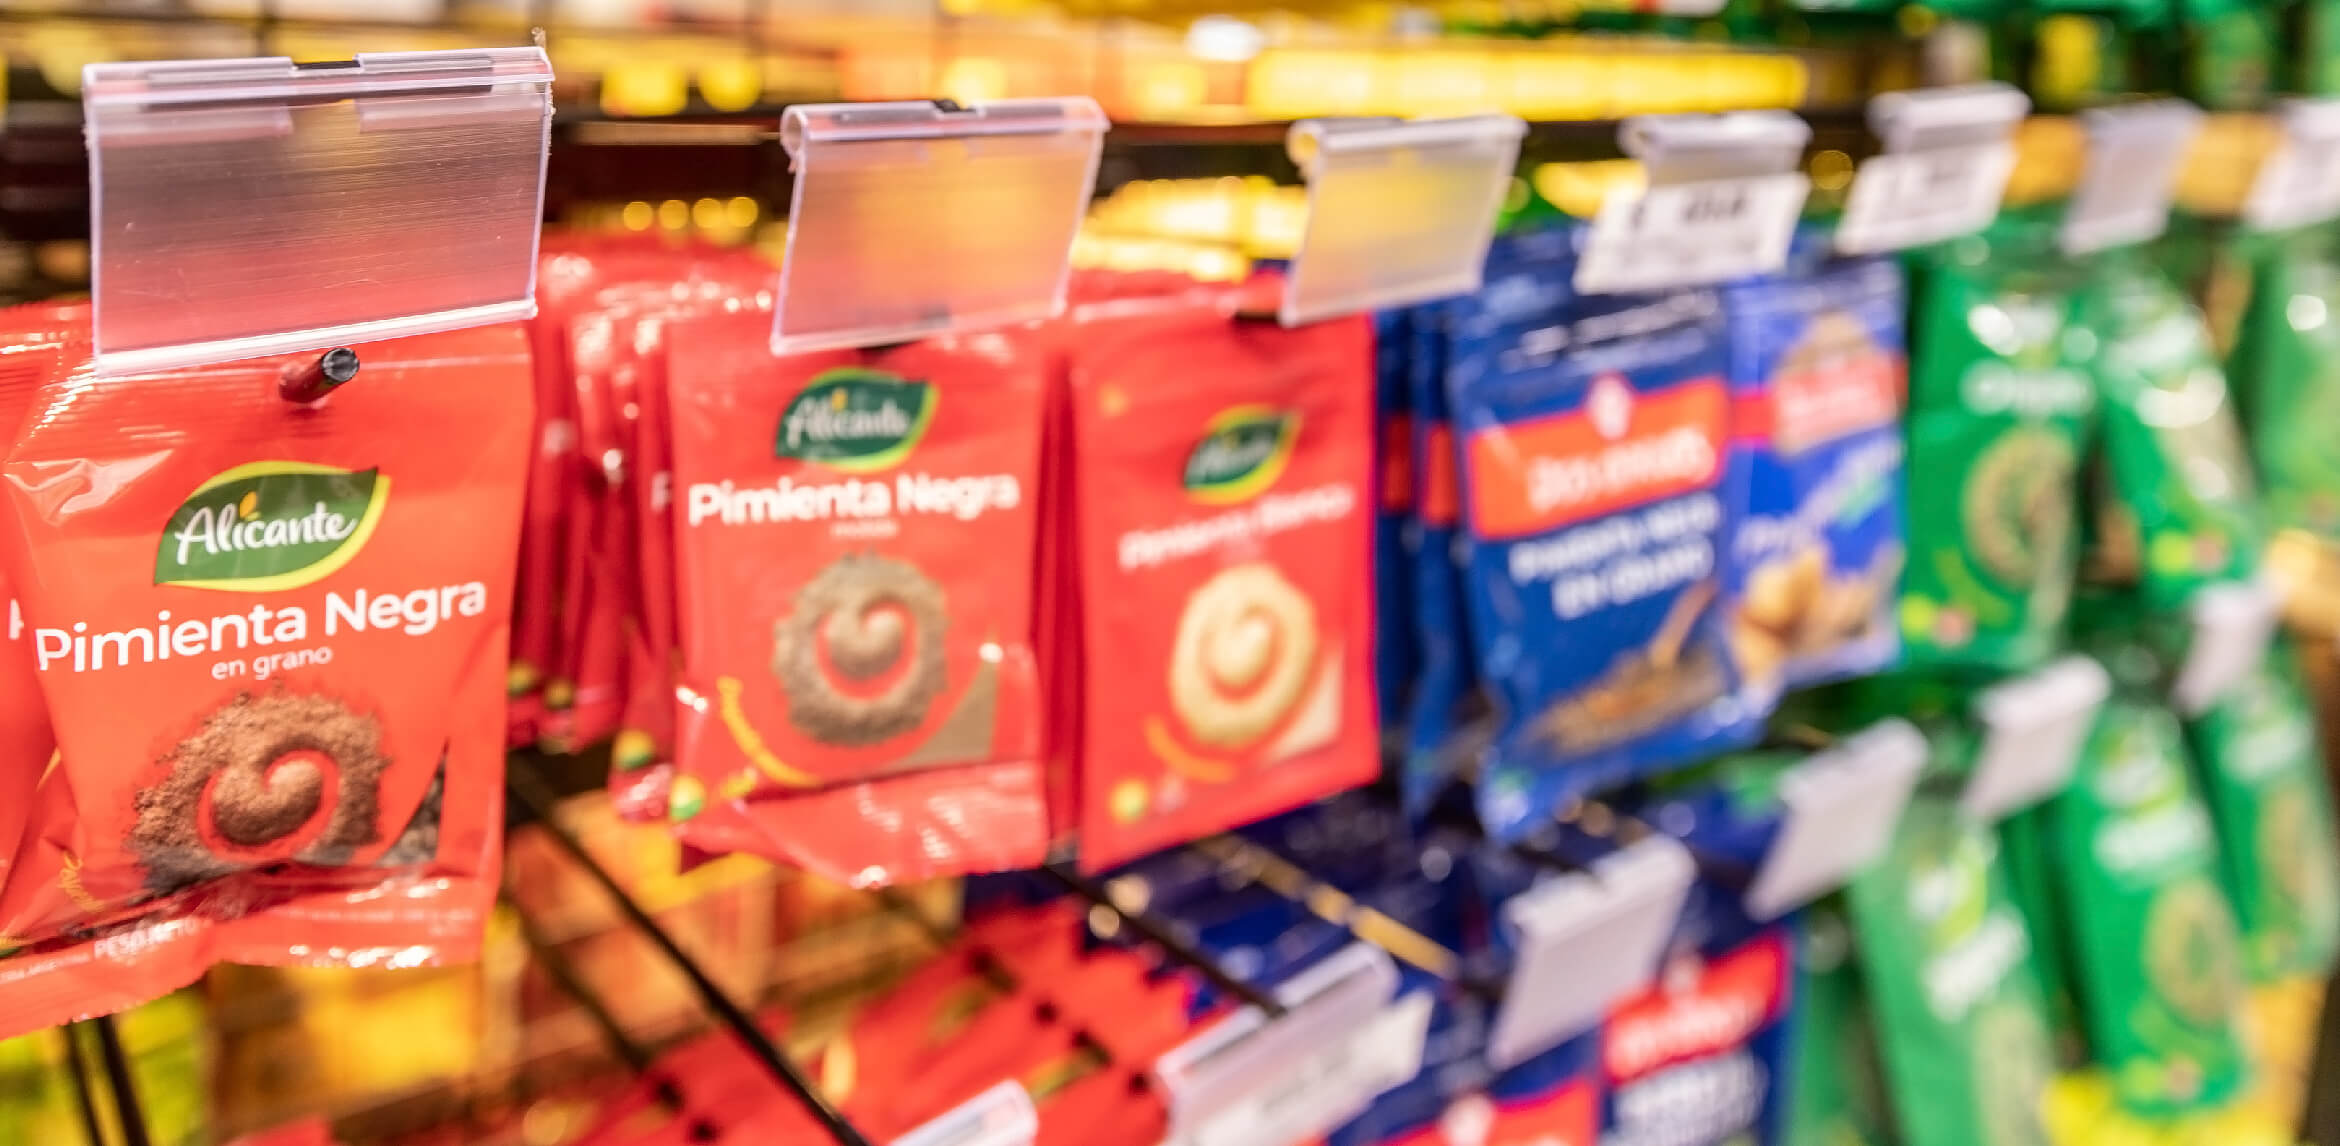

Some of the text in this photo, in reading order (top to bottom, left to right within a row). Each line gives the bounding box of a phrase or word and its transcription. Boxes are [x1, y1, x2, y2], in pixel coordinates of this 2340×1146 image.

[688, 476, 892, 527] Pimienta
[896, 472, 1021, 521] Negra
[174, 499, 358, 565] Alicante
[35, 603, 306, 672] Pimienta
[324, 581, 487, 636] Negra
[211, 645, 334, 681] en grano
[94, 932, 145, 960] PESO
